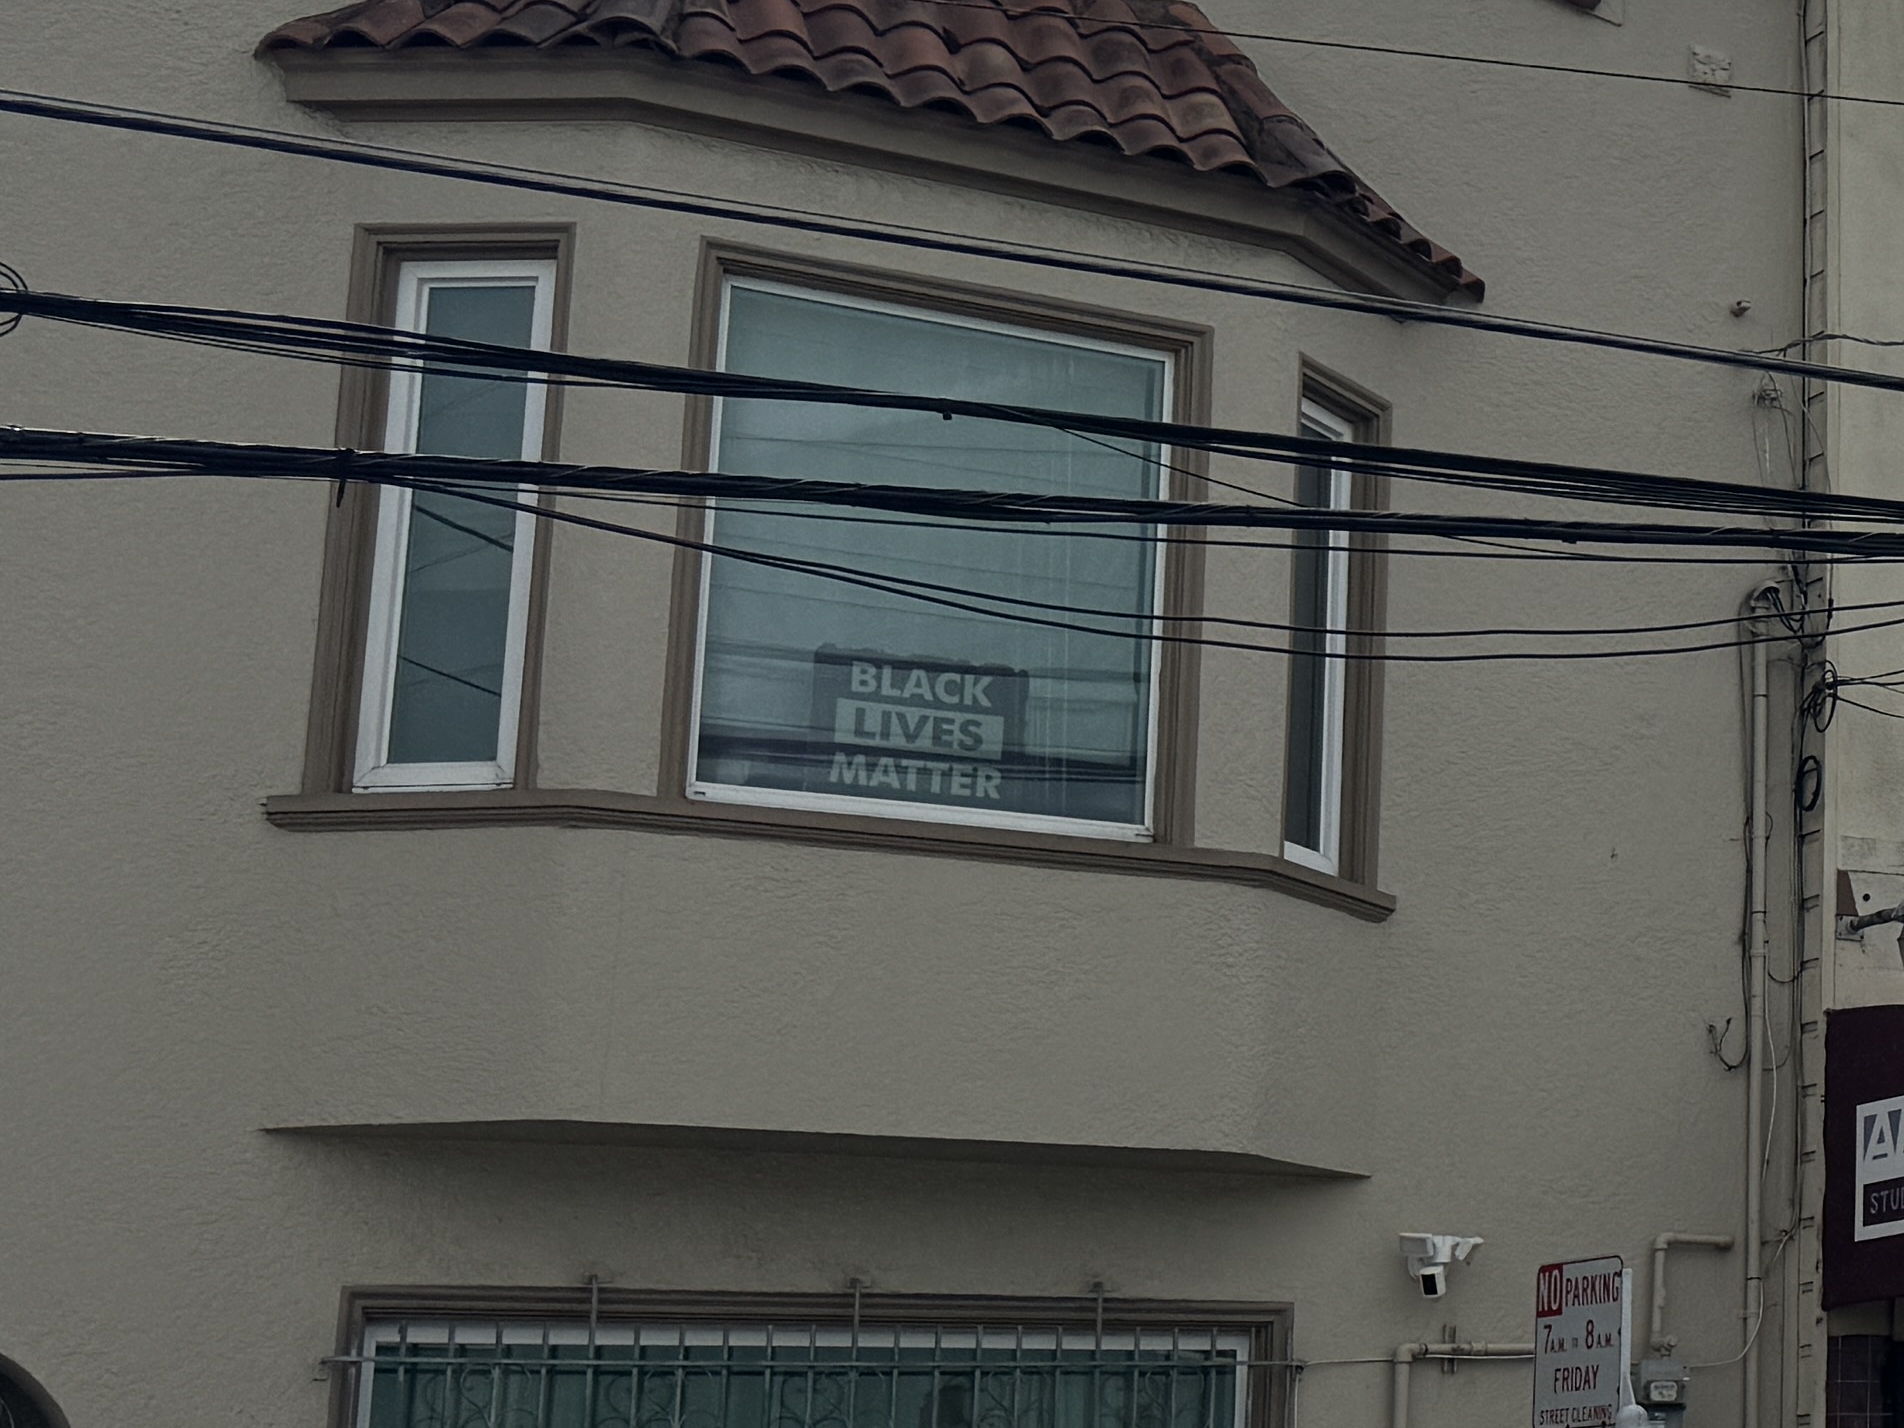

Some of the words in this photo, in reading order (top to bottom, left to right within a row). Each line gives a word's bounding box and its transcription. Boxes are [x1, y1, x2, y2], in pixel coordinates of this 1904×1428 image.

[851, 661, 993, 709] BLACK
[853, 709, 984, 752] LIVES
[828, 752, 1002, 800] MATTER
[1538, 1269, 1561, 1312] NO
[1565, 1272, 1620, 1308] PARKING
[1554, 1365, 1599, 1395] FRIDAY
[1540, 1407, 1570, 1426] STREET
[1571, 1404, 1613, 1423] CLEANING
